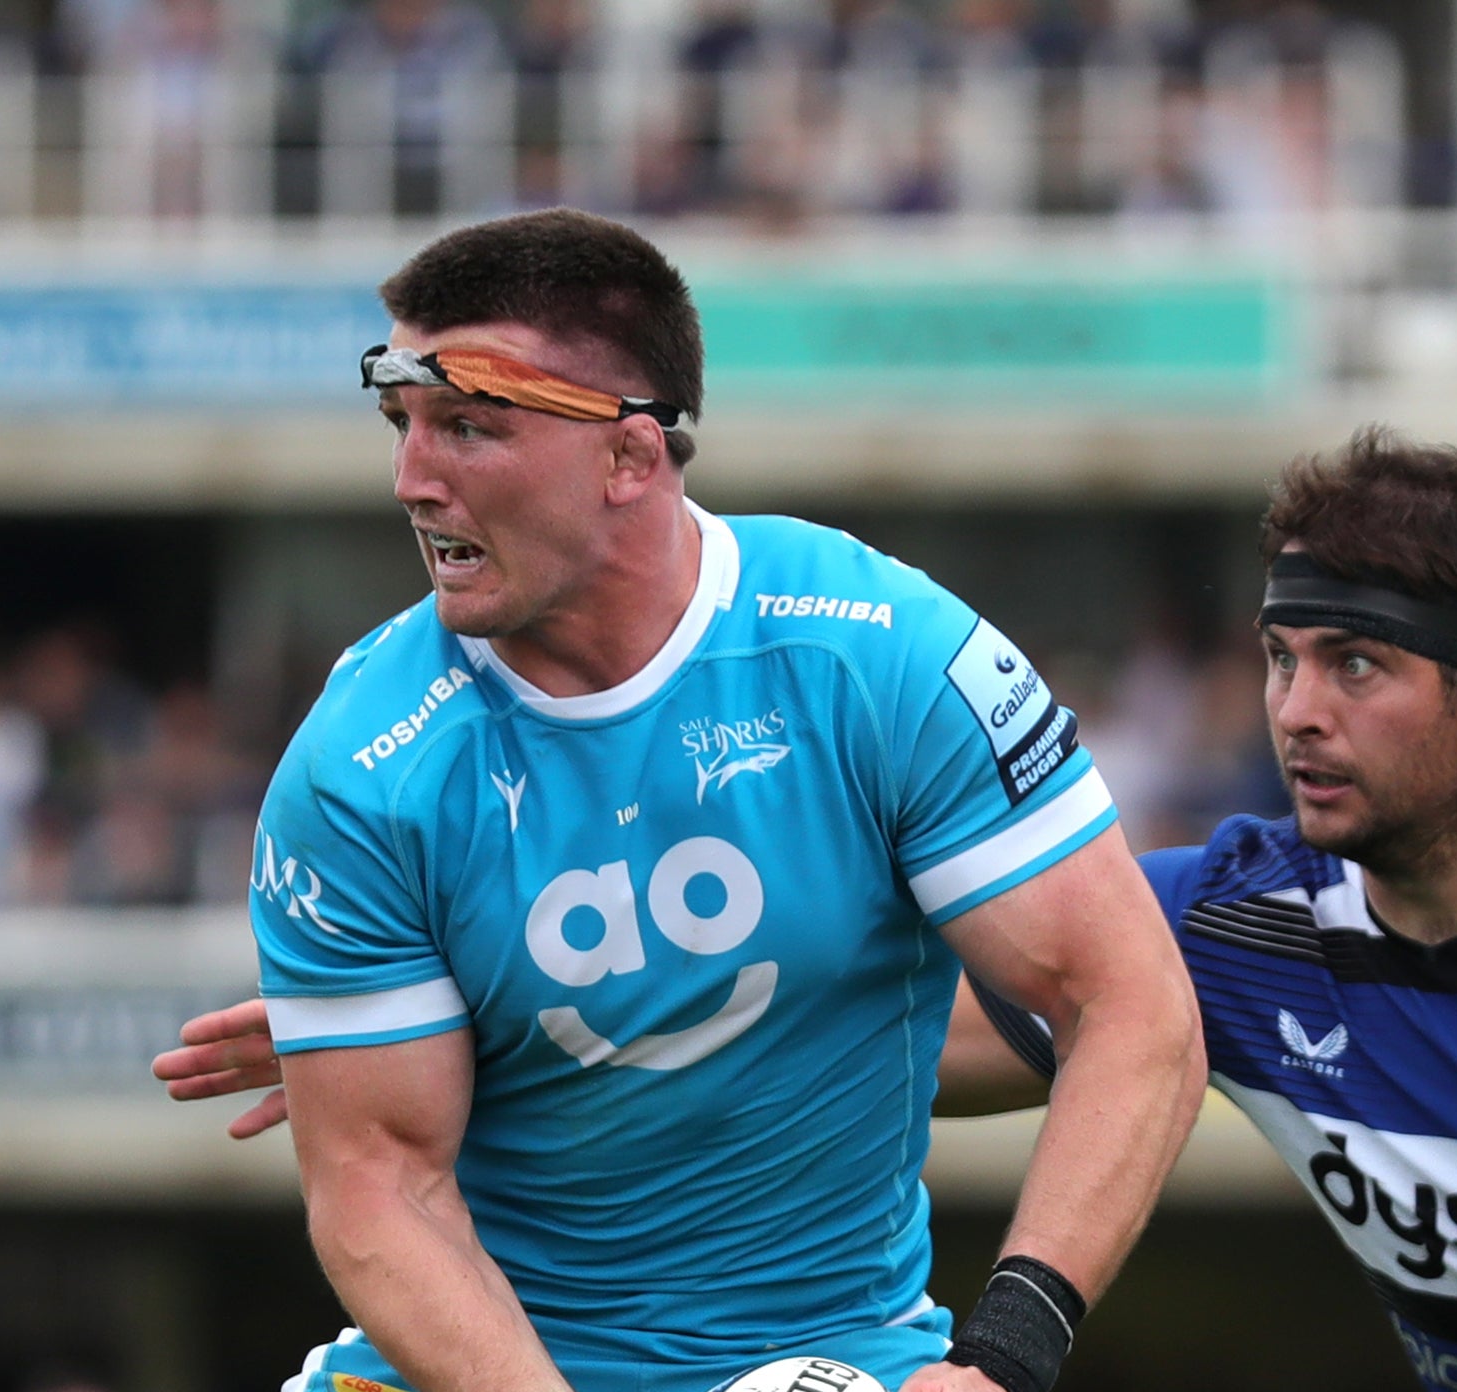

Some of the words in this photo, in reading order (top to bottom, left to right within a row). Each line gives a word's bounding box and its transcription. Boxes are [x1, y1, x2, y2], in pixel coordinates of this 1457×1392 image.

[755, 593, 892, 630] TOSHIBA
[351, 665, 474, 772] TOSHIBA
[681, 707, 786, 758] SHARKS
[1014, 741, 1064, 794] RUGBY
[615, 802, 641, 826] 100
[525, 836, 764, 988] ao
